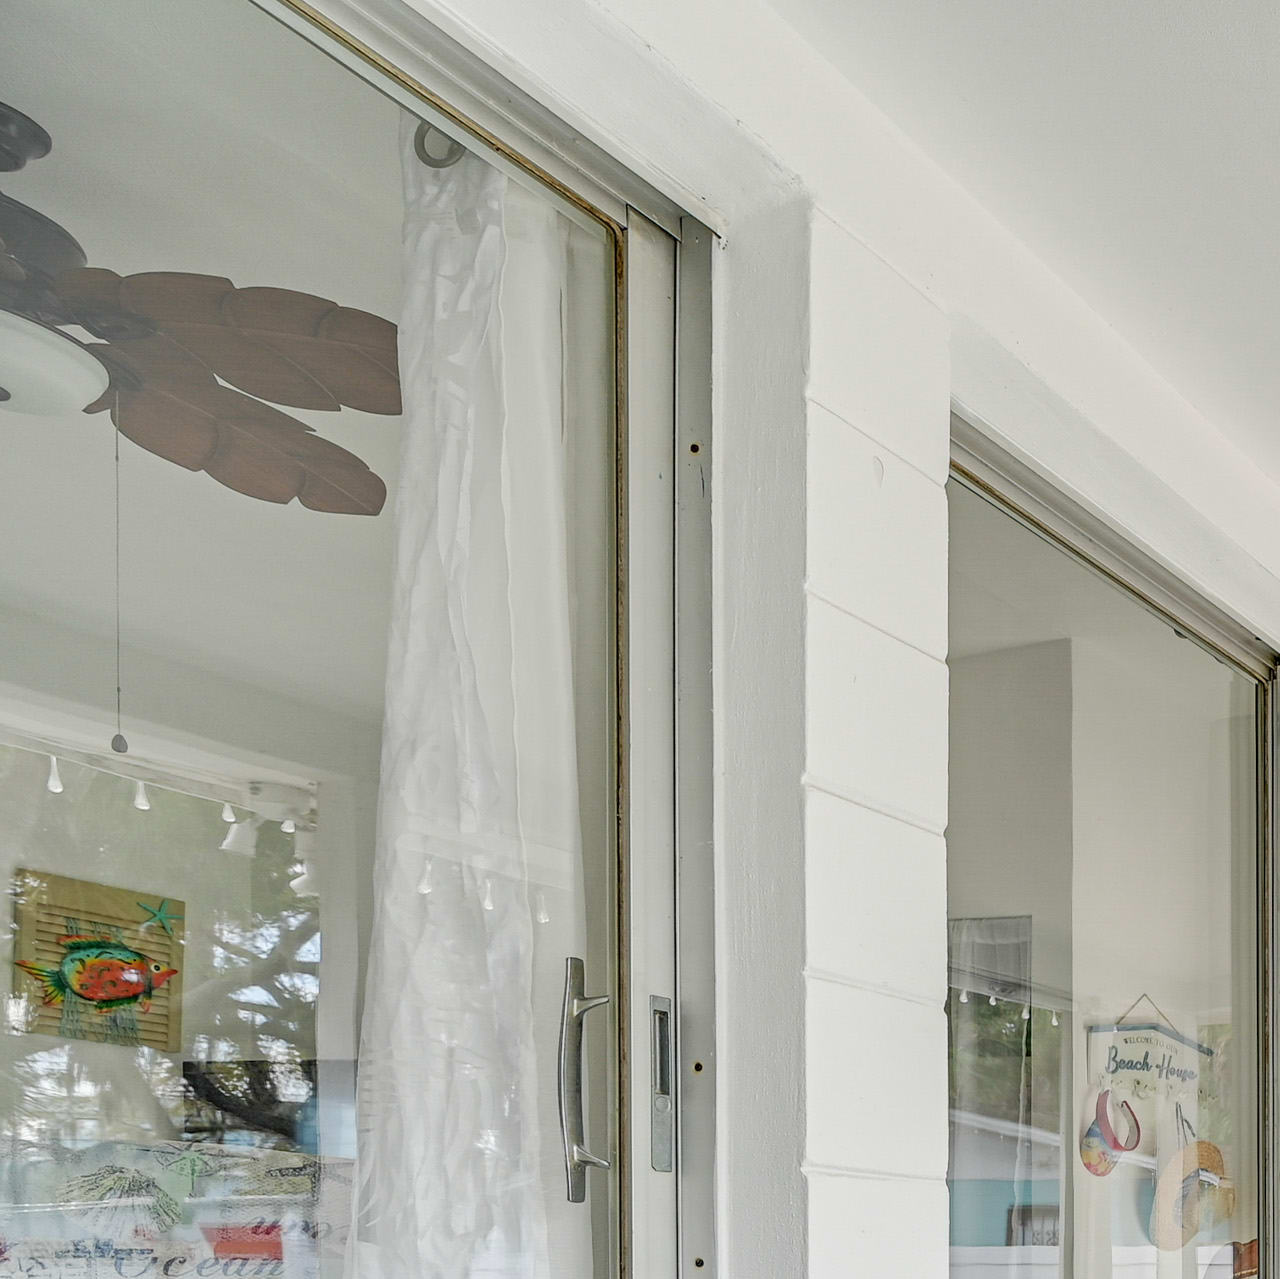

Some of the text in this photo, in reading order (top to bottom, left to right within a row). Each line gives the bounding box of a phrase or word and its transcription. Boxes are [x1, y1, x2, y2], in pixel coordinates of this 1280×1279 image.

[1105, 1045, 1197, 1081] Beach House
[115, 1249, 283, 1277] Ocean
